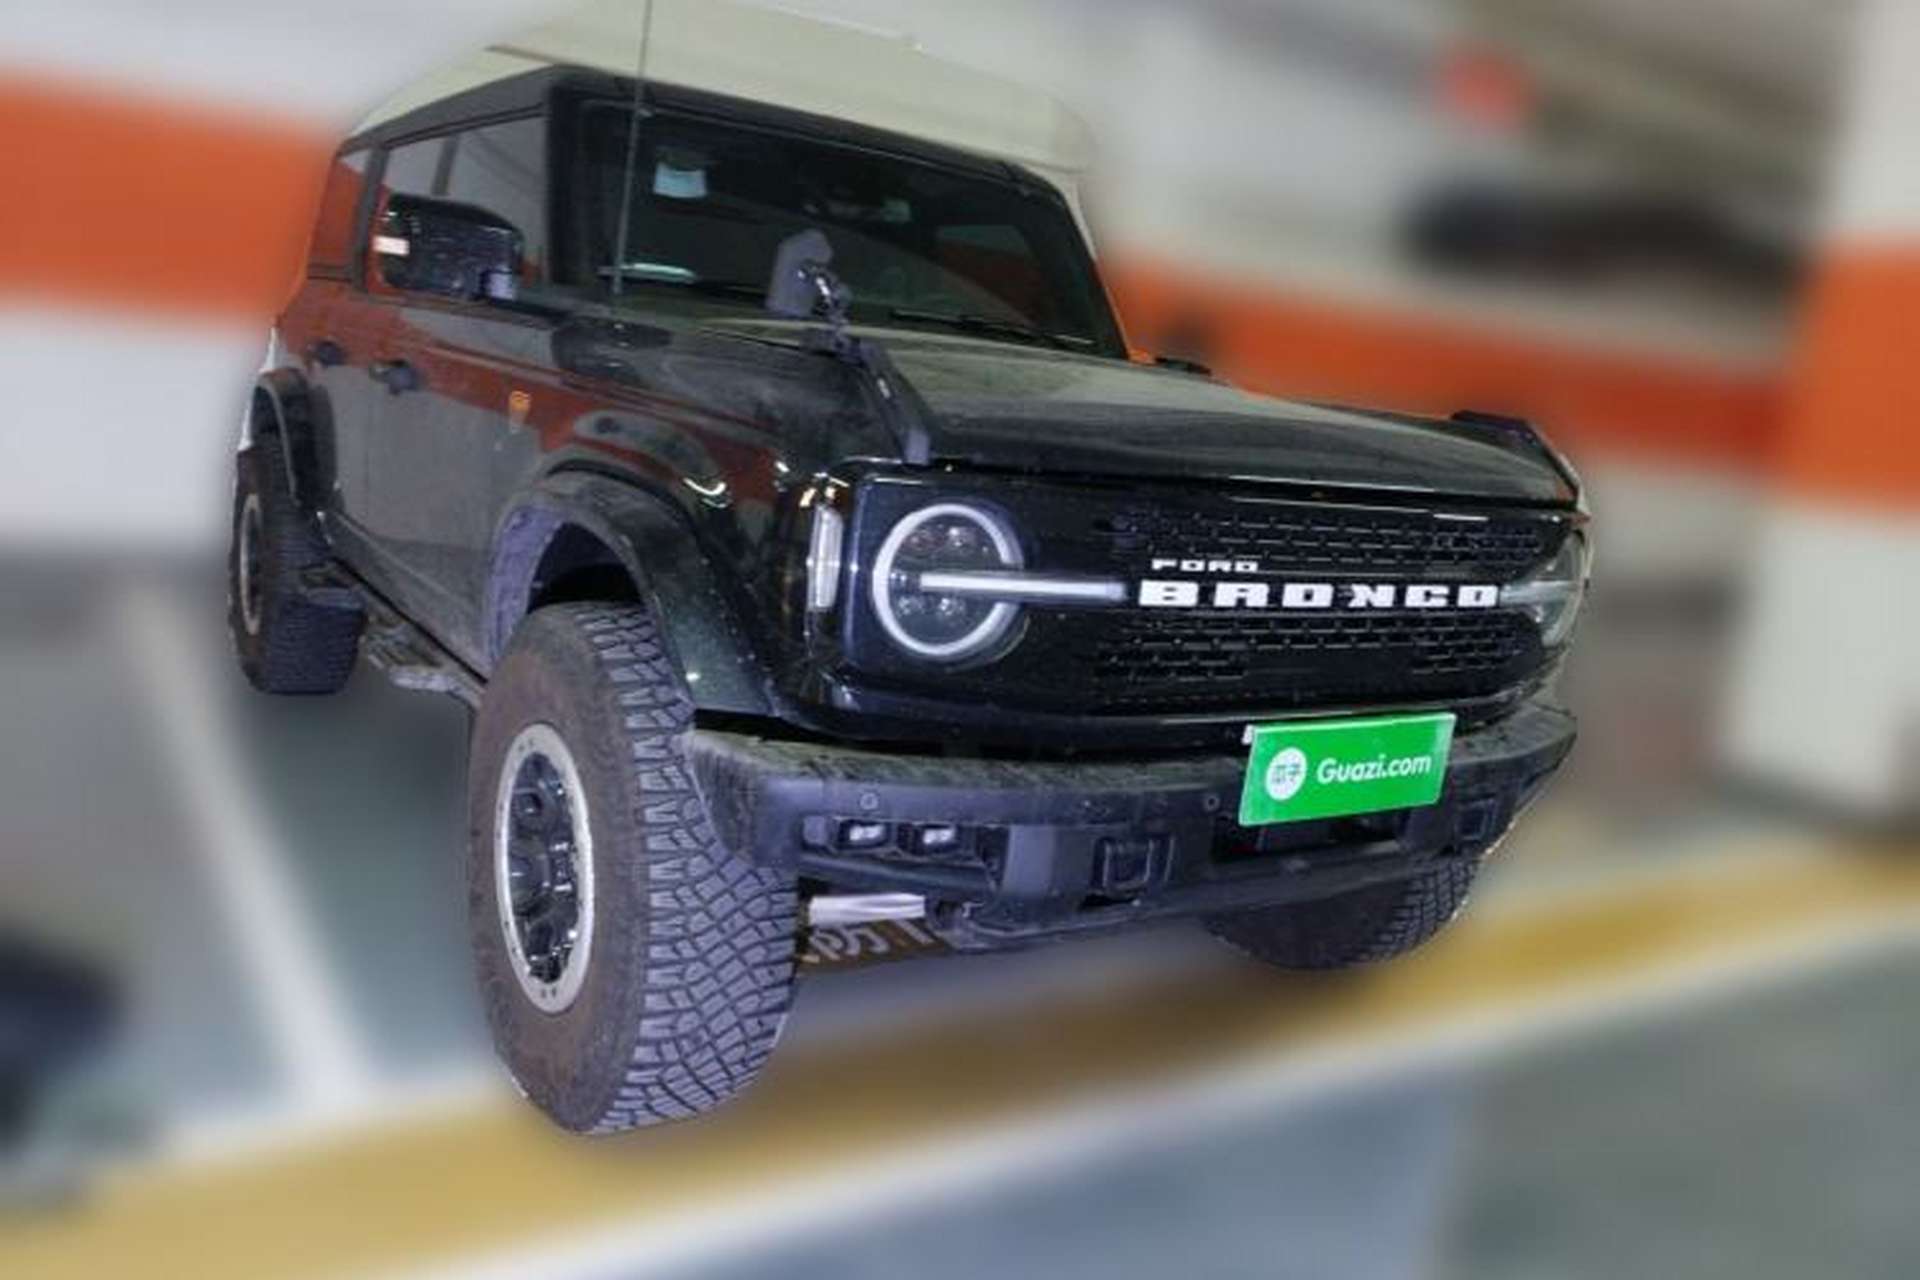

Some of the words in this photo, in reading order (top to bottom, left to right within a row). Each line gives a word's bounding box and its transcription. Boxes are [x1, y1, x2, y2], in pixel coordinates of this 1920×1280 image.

[1151, 559, 1259, 573] FORD
[1138, 580, 1499, 608] BRONCO
[1317, 753, 1432, 785] Guazi.com
